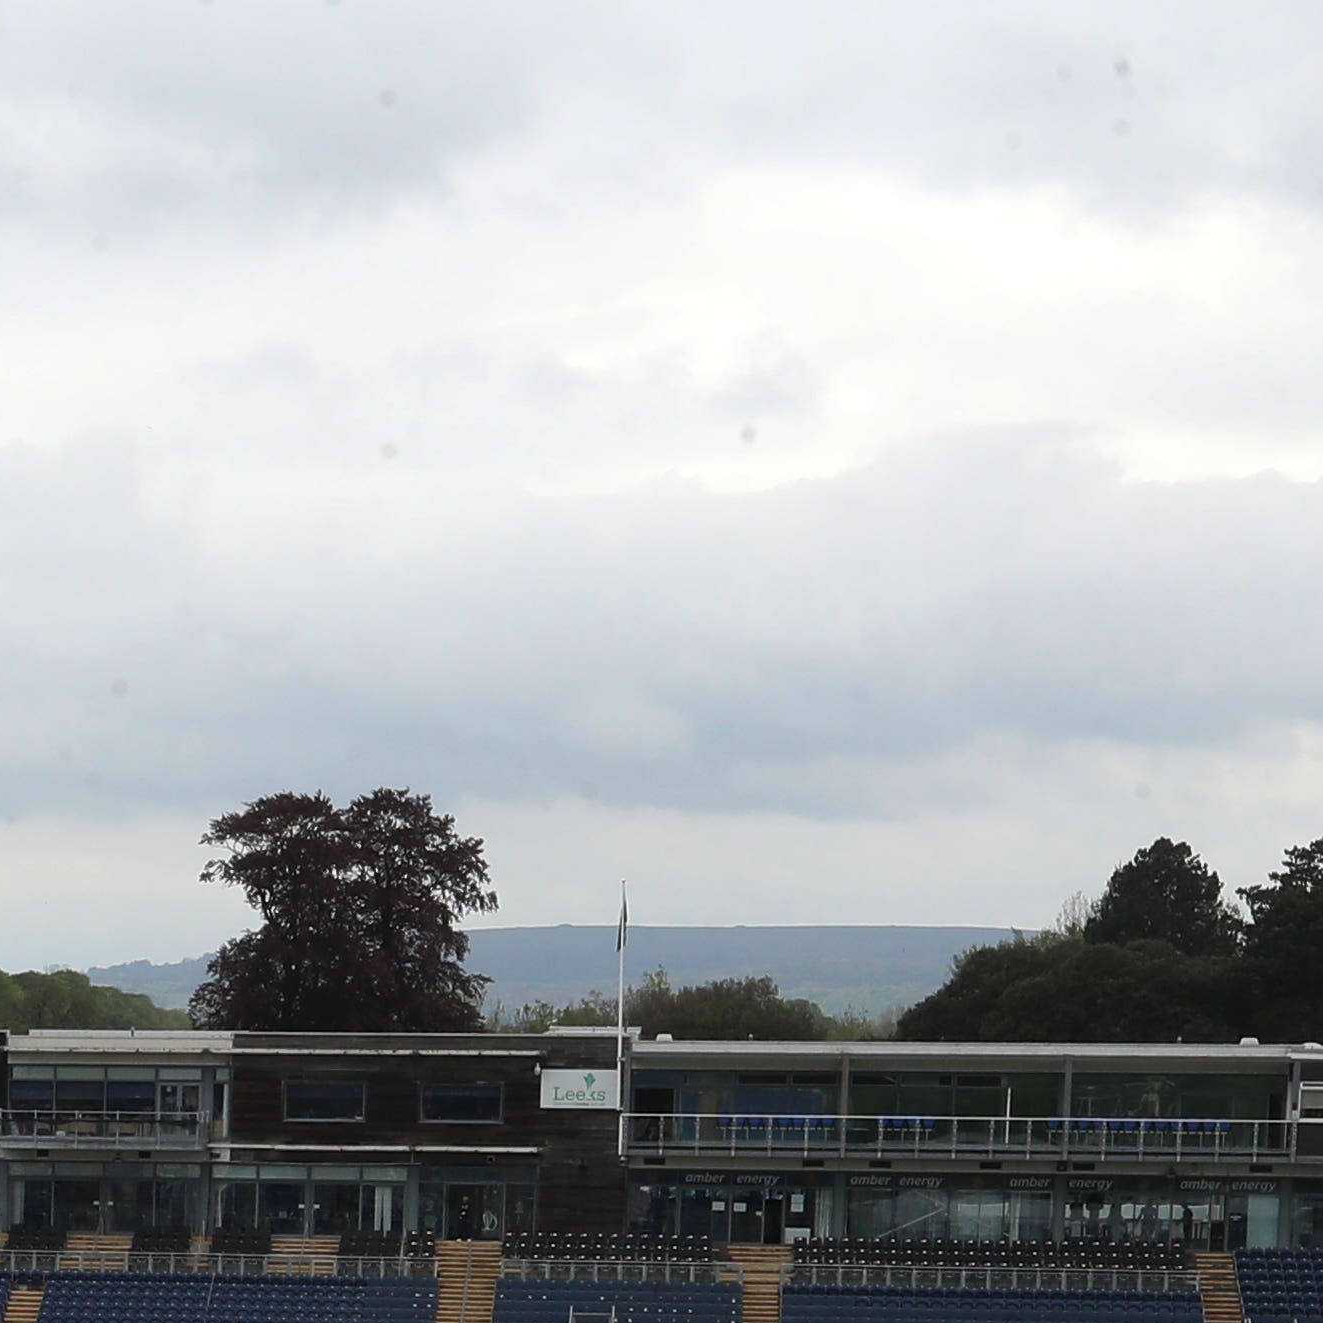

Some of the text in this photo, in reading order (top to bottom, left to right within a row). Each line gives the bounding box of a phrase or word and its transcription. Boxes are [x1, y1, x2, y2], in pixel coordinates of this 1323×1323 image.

[685, 1172, 780, 1186] amber energy
[850, 1174, 943, 1188] amber energy
[1009, 1176, 1114, 1191] amber energy
[1179, 1178, 1276, 1193] amber energy
